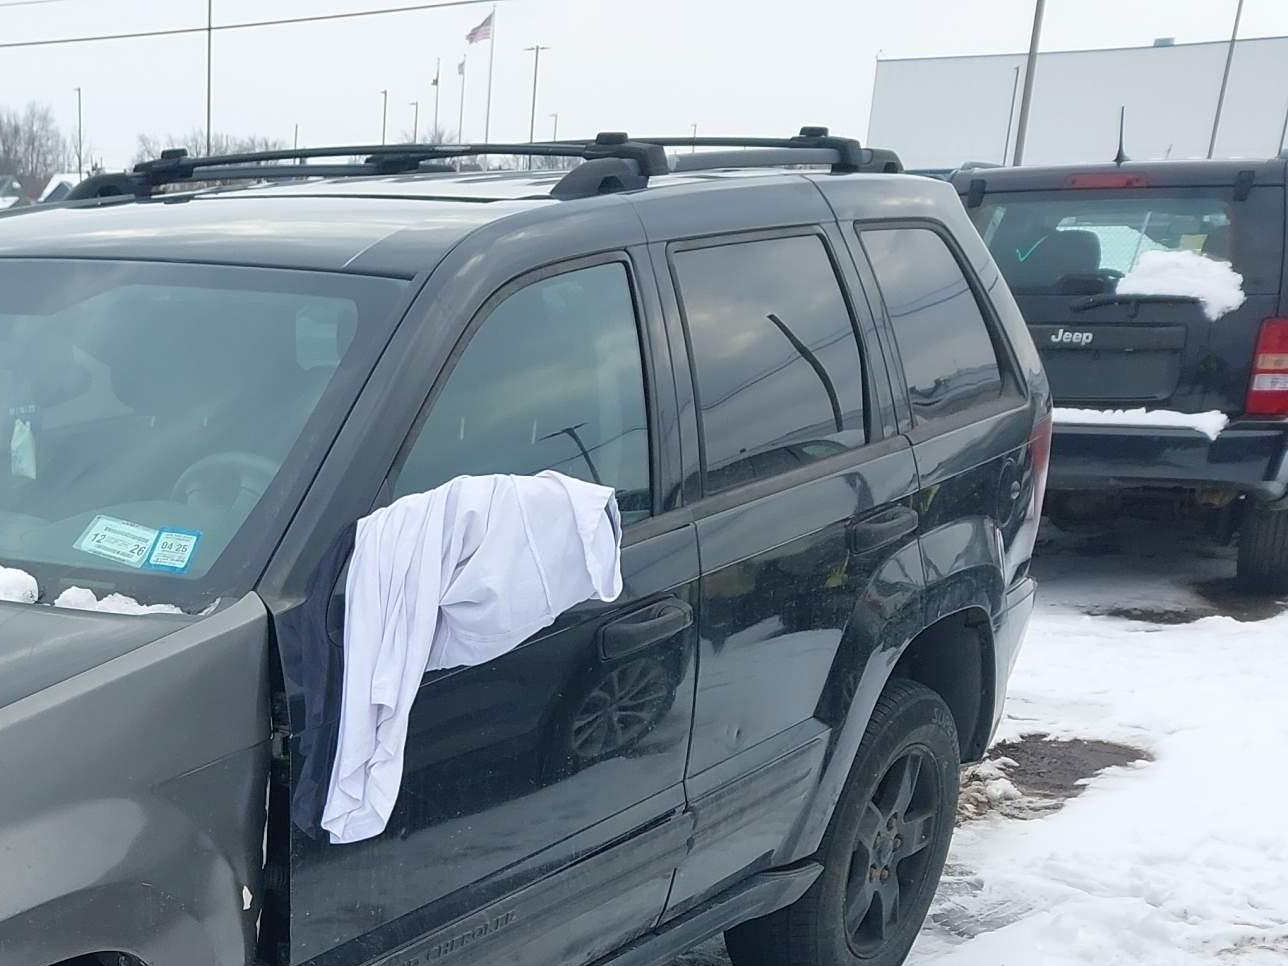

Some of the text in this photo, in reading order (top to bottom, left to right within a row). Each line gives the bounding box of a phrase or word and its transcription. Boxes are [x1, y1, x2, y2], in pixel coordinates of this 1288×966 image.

[1050, 328, 1093, 346] Jeep
[91, 533, 106, 544] 12
[129, 544, 146, 556] 26
[160, 541, 188, 553] 04 25
